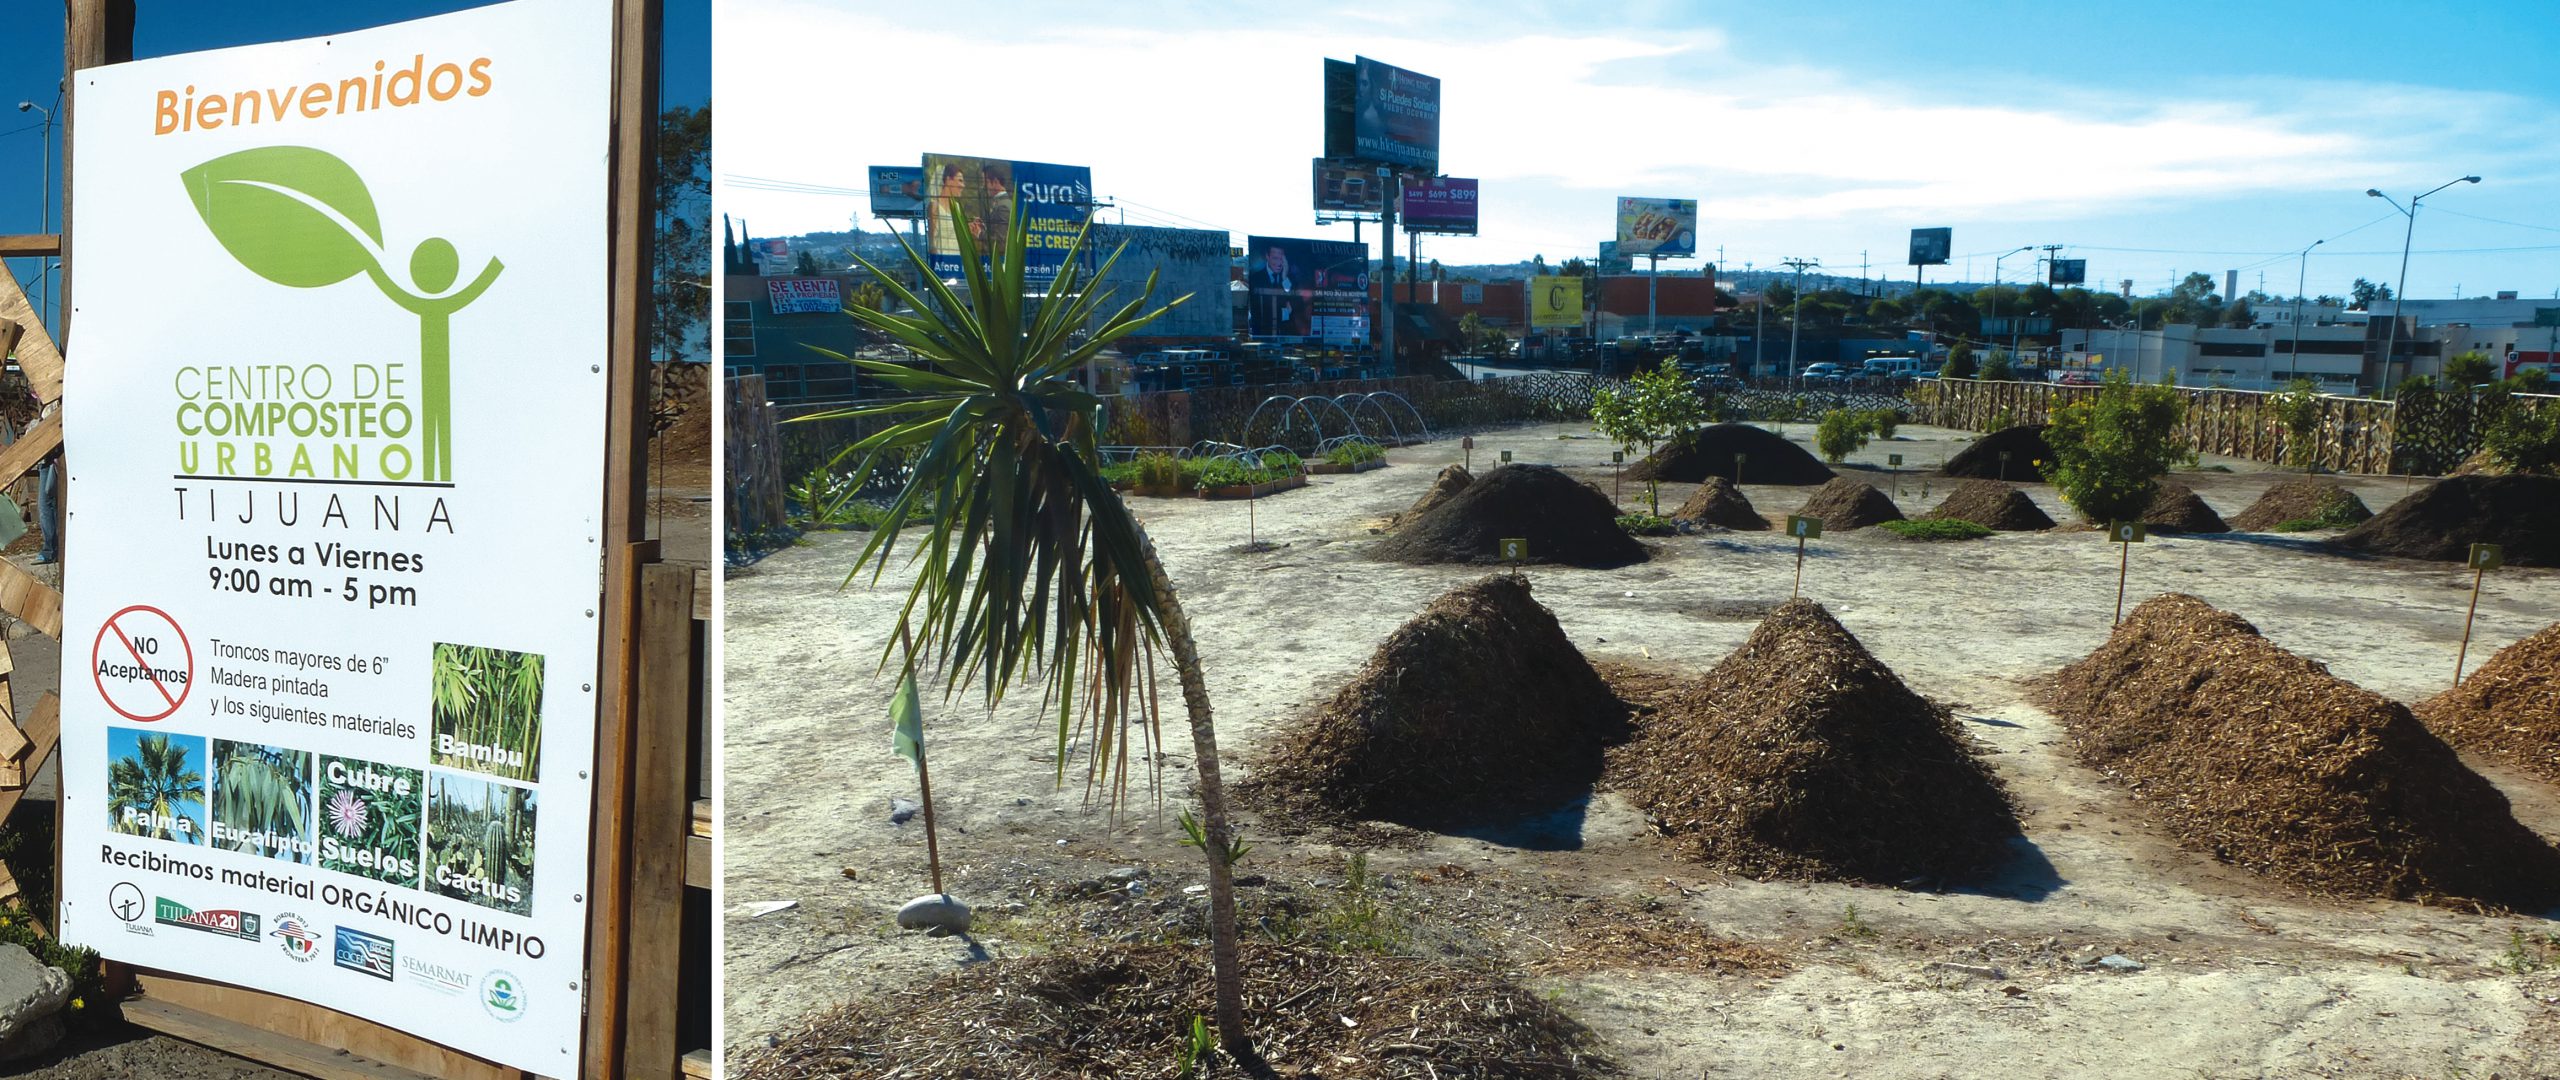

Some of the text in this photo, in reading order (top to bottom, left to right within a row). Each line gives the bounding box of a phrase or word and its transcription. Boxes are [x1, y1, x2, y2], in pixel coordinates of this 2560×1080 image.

[155, 54, 492, 136] Bienvenidos
[1021, 182, 1073, 204] sura
[1449, 188, 1476, 200] $899
[1026, 234, 1042, 248] ES
[934, 262, 960, 273] Afore
[770, 280, 837, 292] SE RENTA
[175, 363, 404, 400] CENTRO DE
[176, 402, 412, 438] COMPOSTEO
[180, 441, 413, 480] URBANO
[174, 487, 453, 534] TIJUANA
[1796, 520, 1808, 536] R
[207, 535, 424, 573] Lunes a Viernes
[1507, 543, 1518, 558] S
[2479, 549, 2490, 565] P
[209, 566, 260, 593] 9:00
[269, 576, 312, 598] am
[343, 577, 358, 601] 5
[369, 583, 417, 609] pm
[133, 637, 158, 655] NO
[211, 639, 269, 662] Troncos
[275, 650, 341, 672] mayores
[347, 654, 367, 673] de
[98, 659, 188, 684] Aceptamos
[211, 666, 328, 698] Madera pintada
[211, 698, 415, 740] y los siguientes materiales
[439, 733, 522, 768] Bambu
[327, 761, 411, 796] Cubre
[123, 806, 191, 833] Palma
[212, 821, 312, 854] Eucalipto
[322, 837, 414, 878] Suelos
[435, 865, 521, 903] Cactus
[101, 844, 545, 960] Recibimos material ORGÁNICO LIMPIO
[273, 911, 296, 924] BORDER
[402, 956, 472, 987] SEMARNAT
